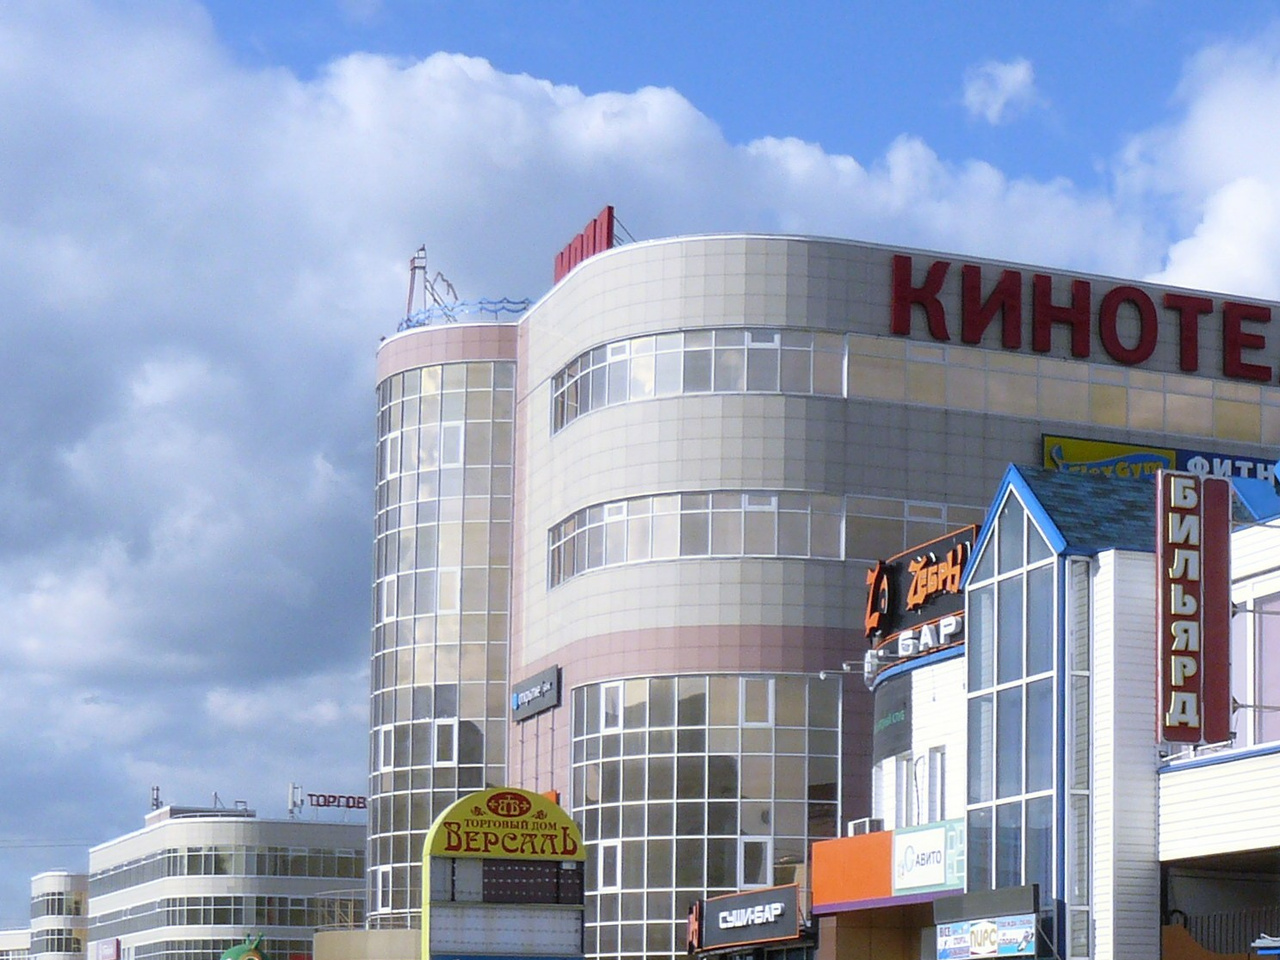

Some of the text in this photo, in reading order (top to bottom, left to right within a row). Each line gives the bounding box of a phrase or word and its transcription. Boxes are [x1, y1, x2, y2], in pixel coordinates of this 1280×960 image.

[1166, 476, 1200, 727] БИЛЬЯРД
[898, 616, 963, 657] БАР
[307, 793, 367, 809] ТОРГОВ
[443, 821, 578, 856] ВЕРСАЛЬ
[464, 818, 557, 832] ТОРГОВЫЙ ДОМ
